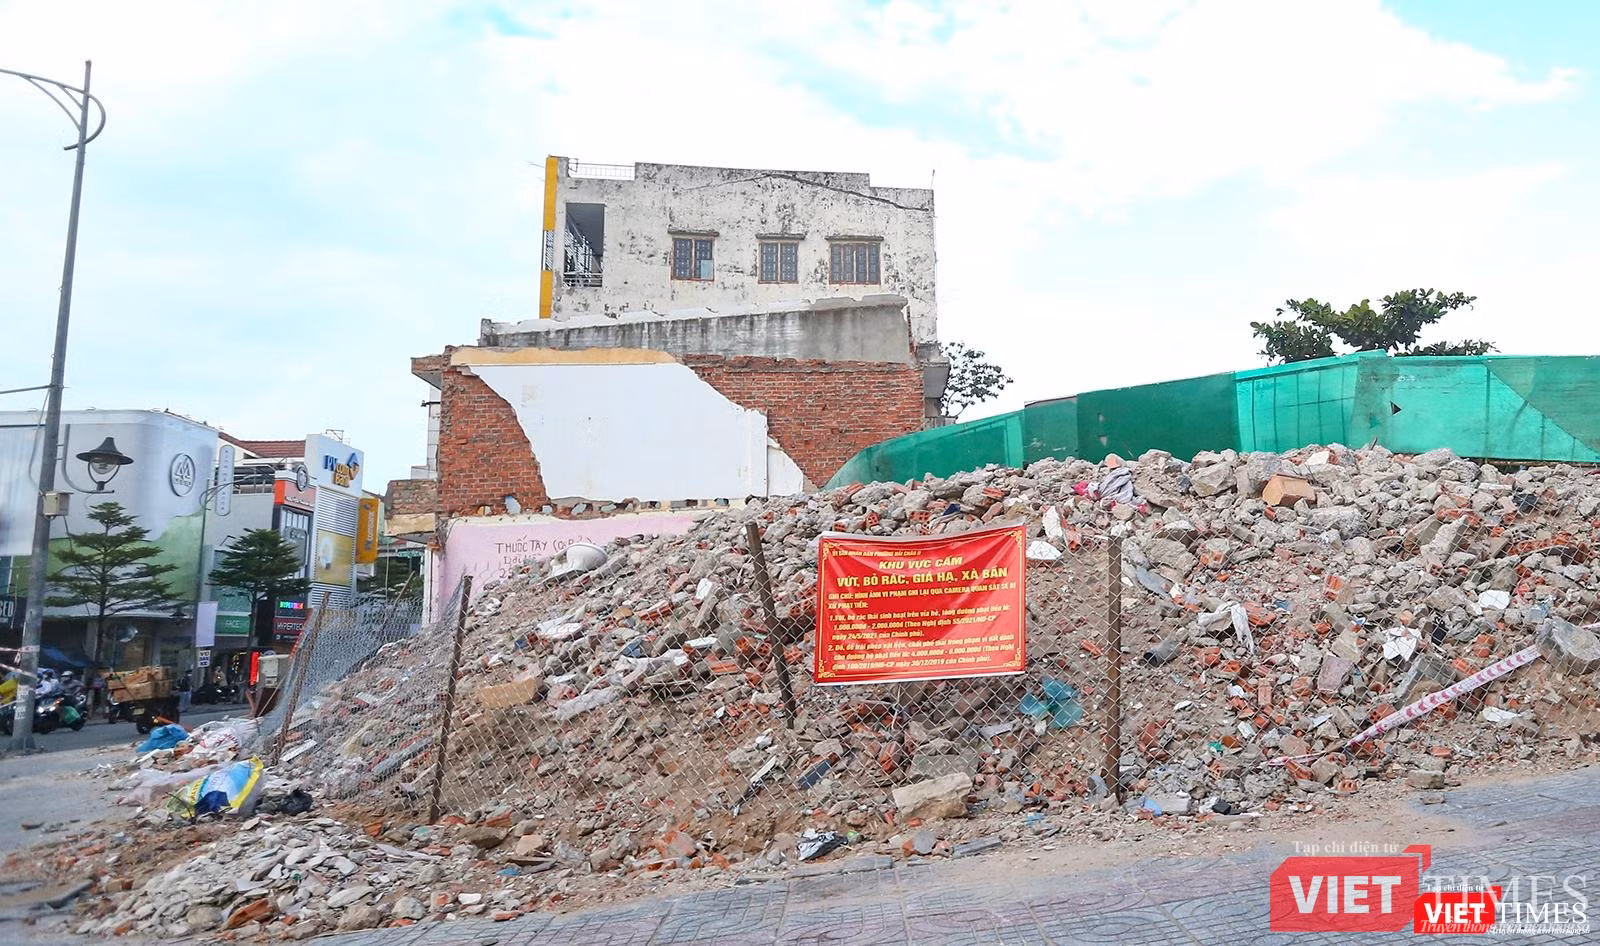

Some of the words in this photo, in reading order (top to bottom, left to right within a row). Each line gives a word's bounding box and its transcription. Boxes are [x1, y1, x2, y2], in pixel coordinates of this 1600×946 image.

[879, 561, 904, 570] KHU
[908, 559, 932, 570] VỰC
[935, 555, 963, 567] CẤM
[837, 576, 860, 588] VỨT,
[863, 573, 878, 586] BỎ
